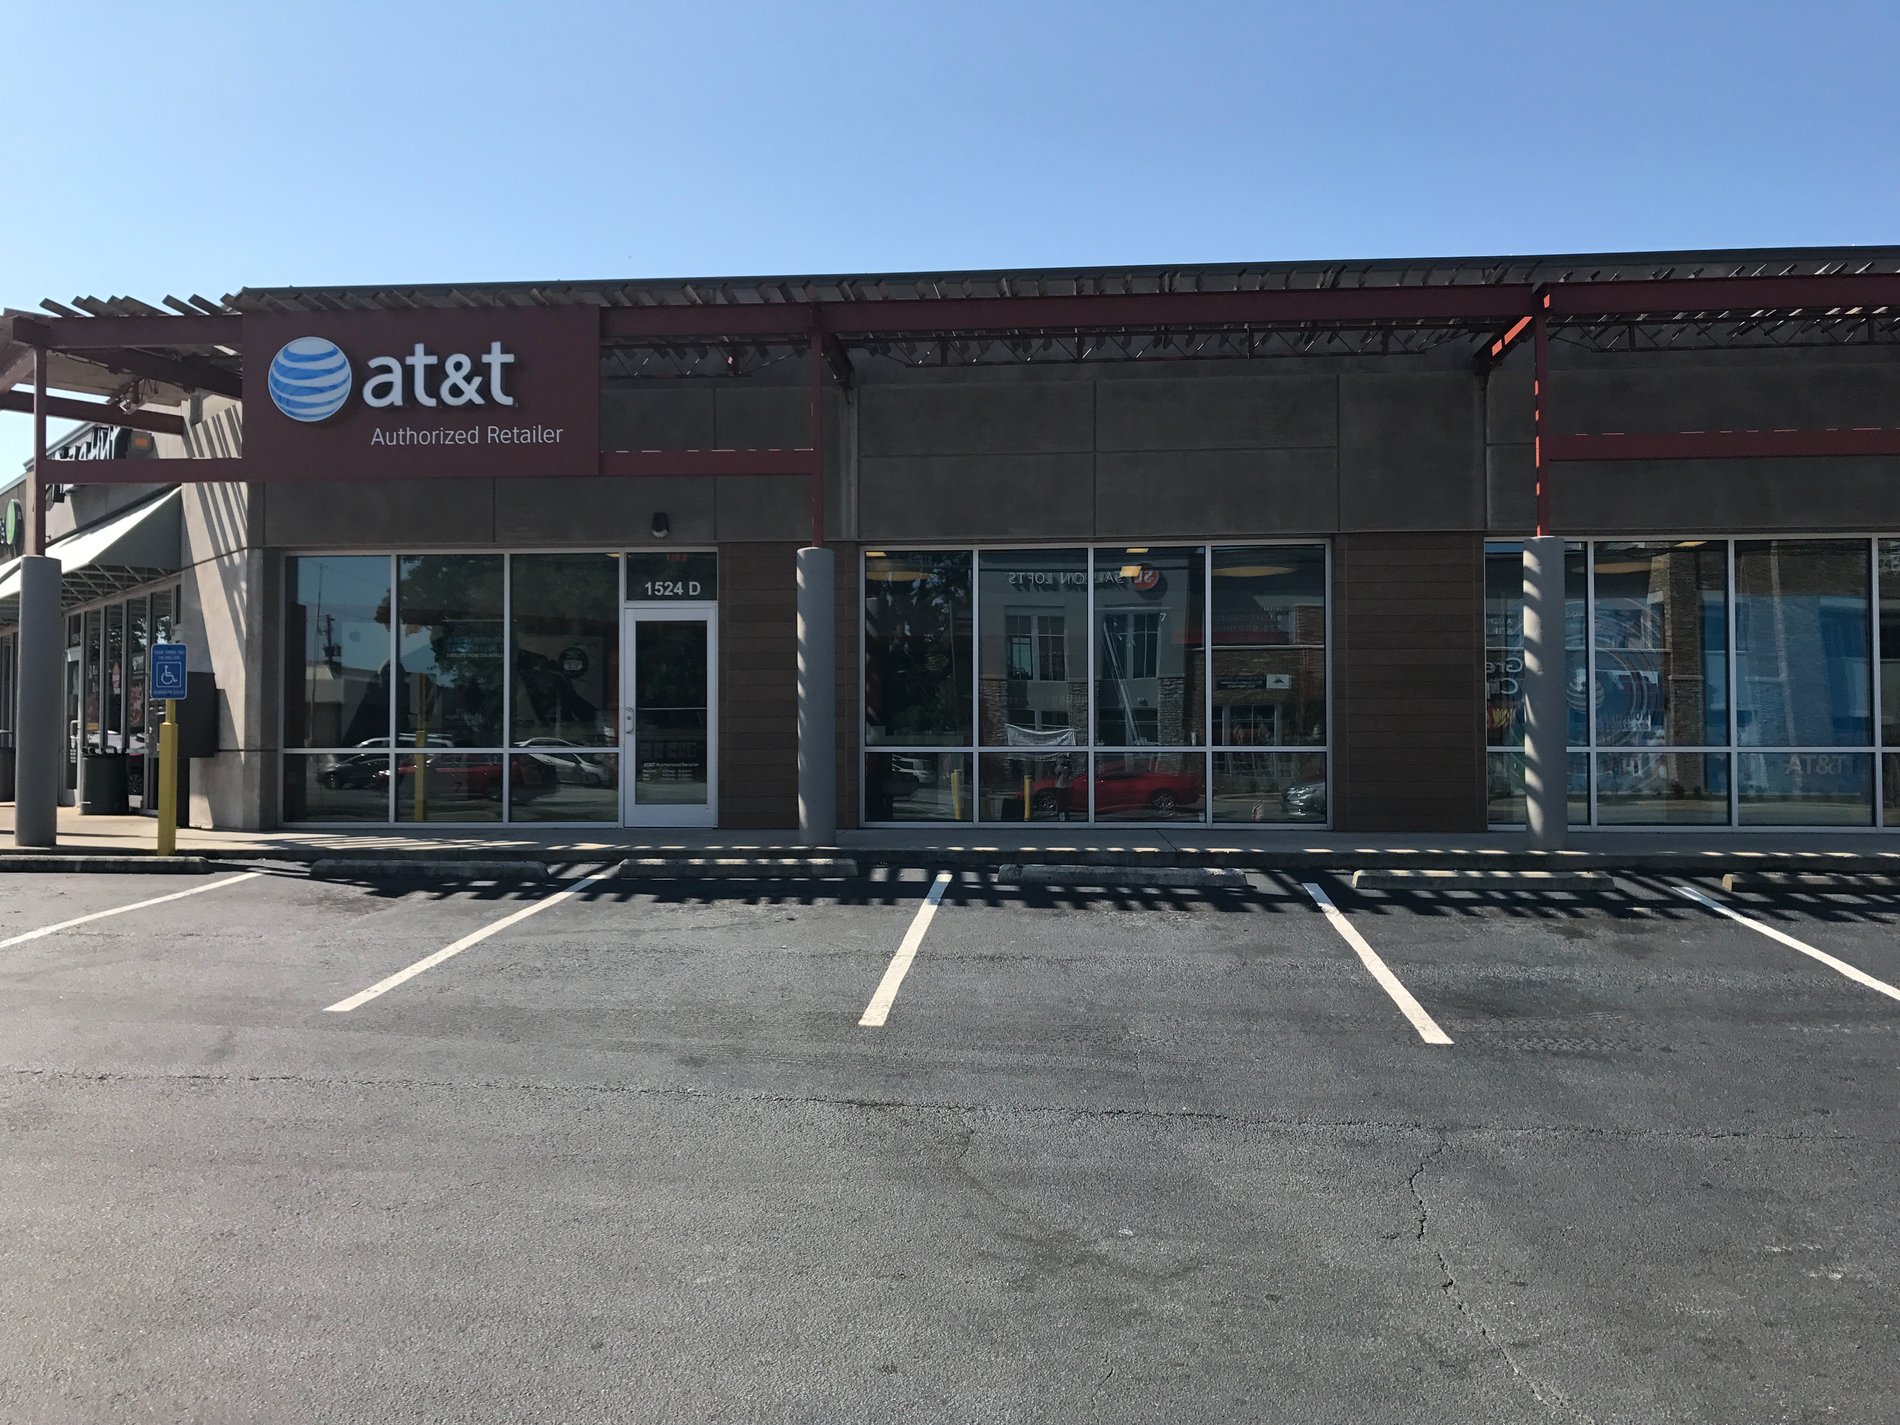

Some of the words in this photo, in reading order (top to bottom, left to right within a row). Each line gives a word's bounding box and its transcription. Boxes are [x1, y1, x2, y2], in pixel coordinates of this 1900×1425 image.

[362, 340, 515, 408] at&t
[371, 426, 479, 445] Authorized
[487, 424, 564, 444] Retailer
[645, 580, 684, 596] 1524
[688, 580, 701, 596] D
